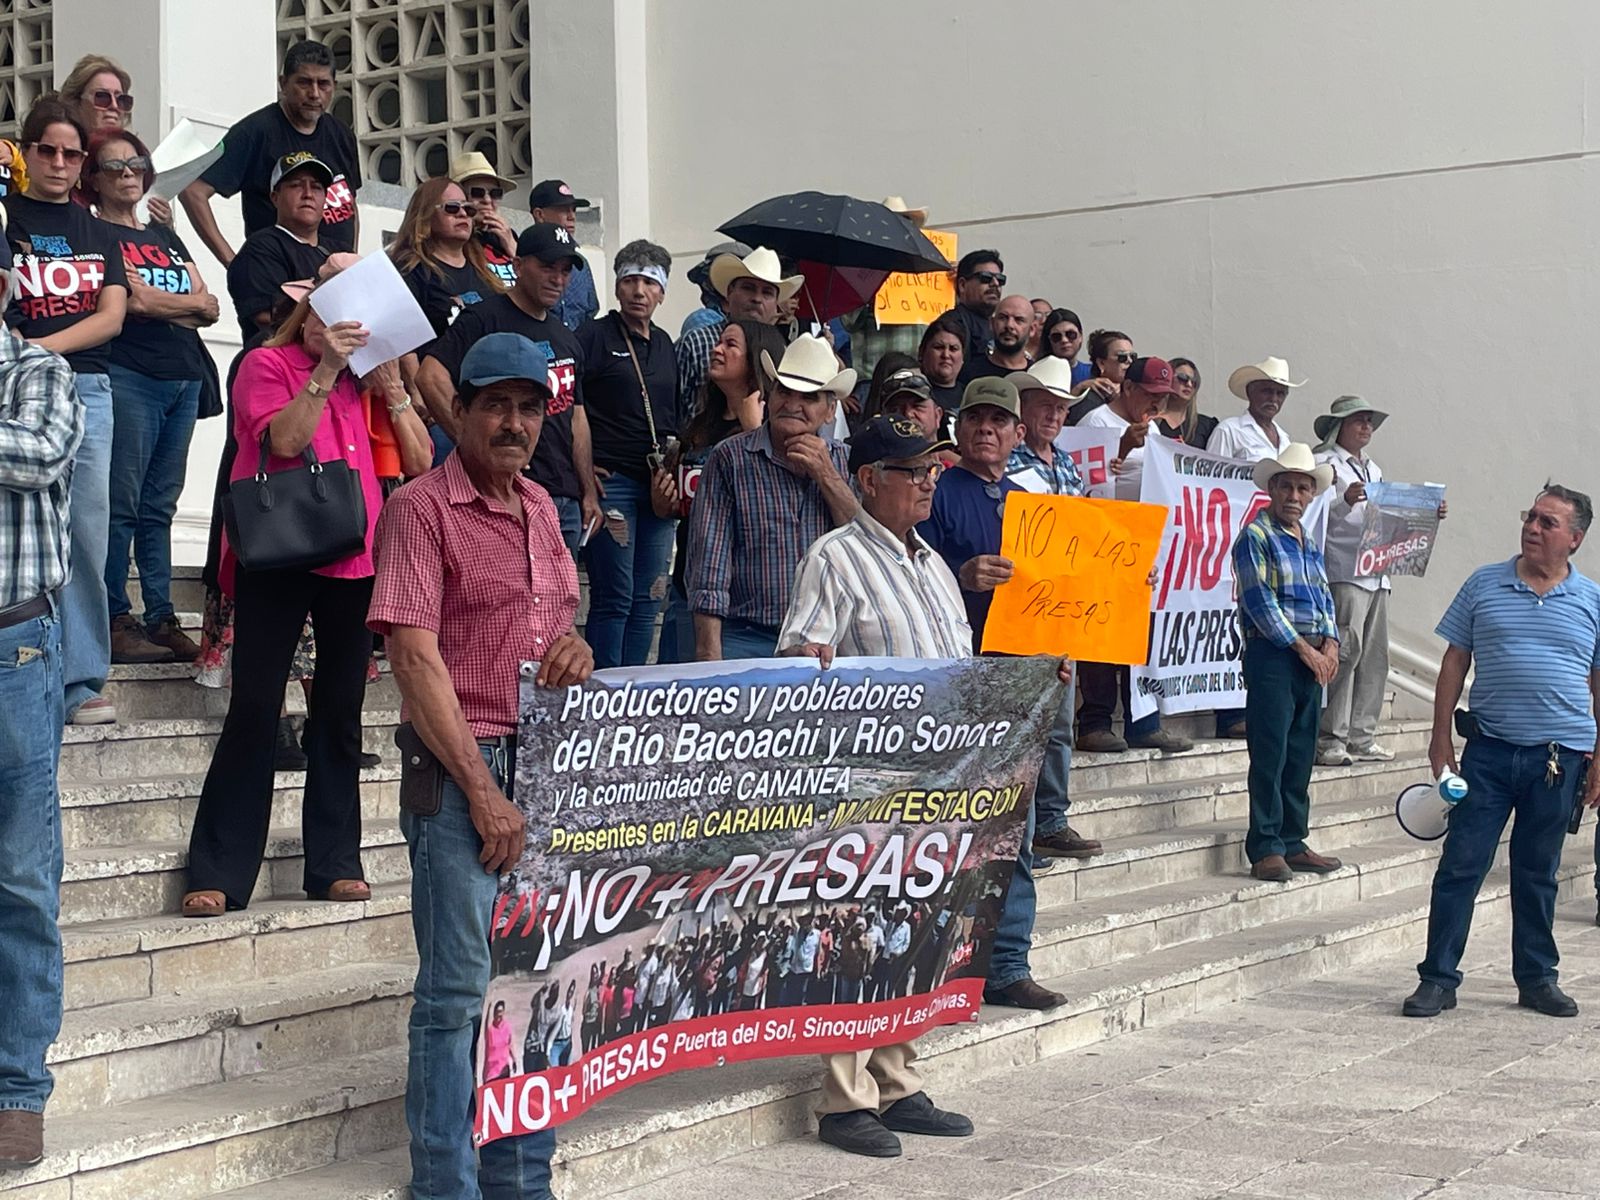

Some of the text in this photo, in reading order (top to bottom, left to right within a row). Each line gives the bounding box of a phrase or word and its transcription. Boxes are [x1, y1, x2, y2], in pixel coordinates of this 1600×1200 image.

[137, 267, 192, 295] RESA
[1014, 503, 1141, 571] NO A LAS
[1020, 578, 1113, 635] PRESAS
[1158, 610, 1196, 668] LAS
[1191, 608, 1244, 665] PRES
[560, 678, 924, 723] Productores y pobladores
[552, 714, 1012, 774] del Río Bacoachi y Río Sonora
[551, 766, 851, 817] y la comunidad de CANANEA
[547, 823, 647, 854] Presentes
[652, 820, 677, 844] en
[681, 814, 699, 840] la
[704, 803, 814, 838] CARAVANA
[533, 864, 652, 971] ¡NO
[695, 831, 974, 913] PRESAS!
[582, 1032, 669, 1104] PRESAS
[672, 1027, 727, 1055] Puerta
[731, 1020, 760, 1045] del
[763, 1018, 797, 1043] Sol,
[802, 1013, 889, 1040] Sinoquipe
[889, 1012, 903, 1034] y
[903, 1006, 928, 1027] Las
[927, 991, 971, 1018] Chivas.
